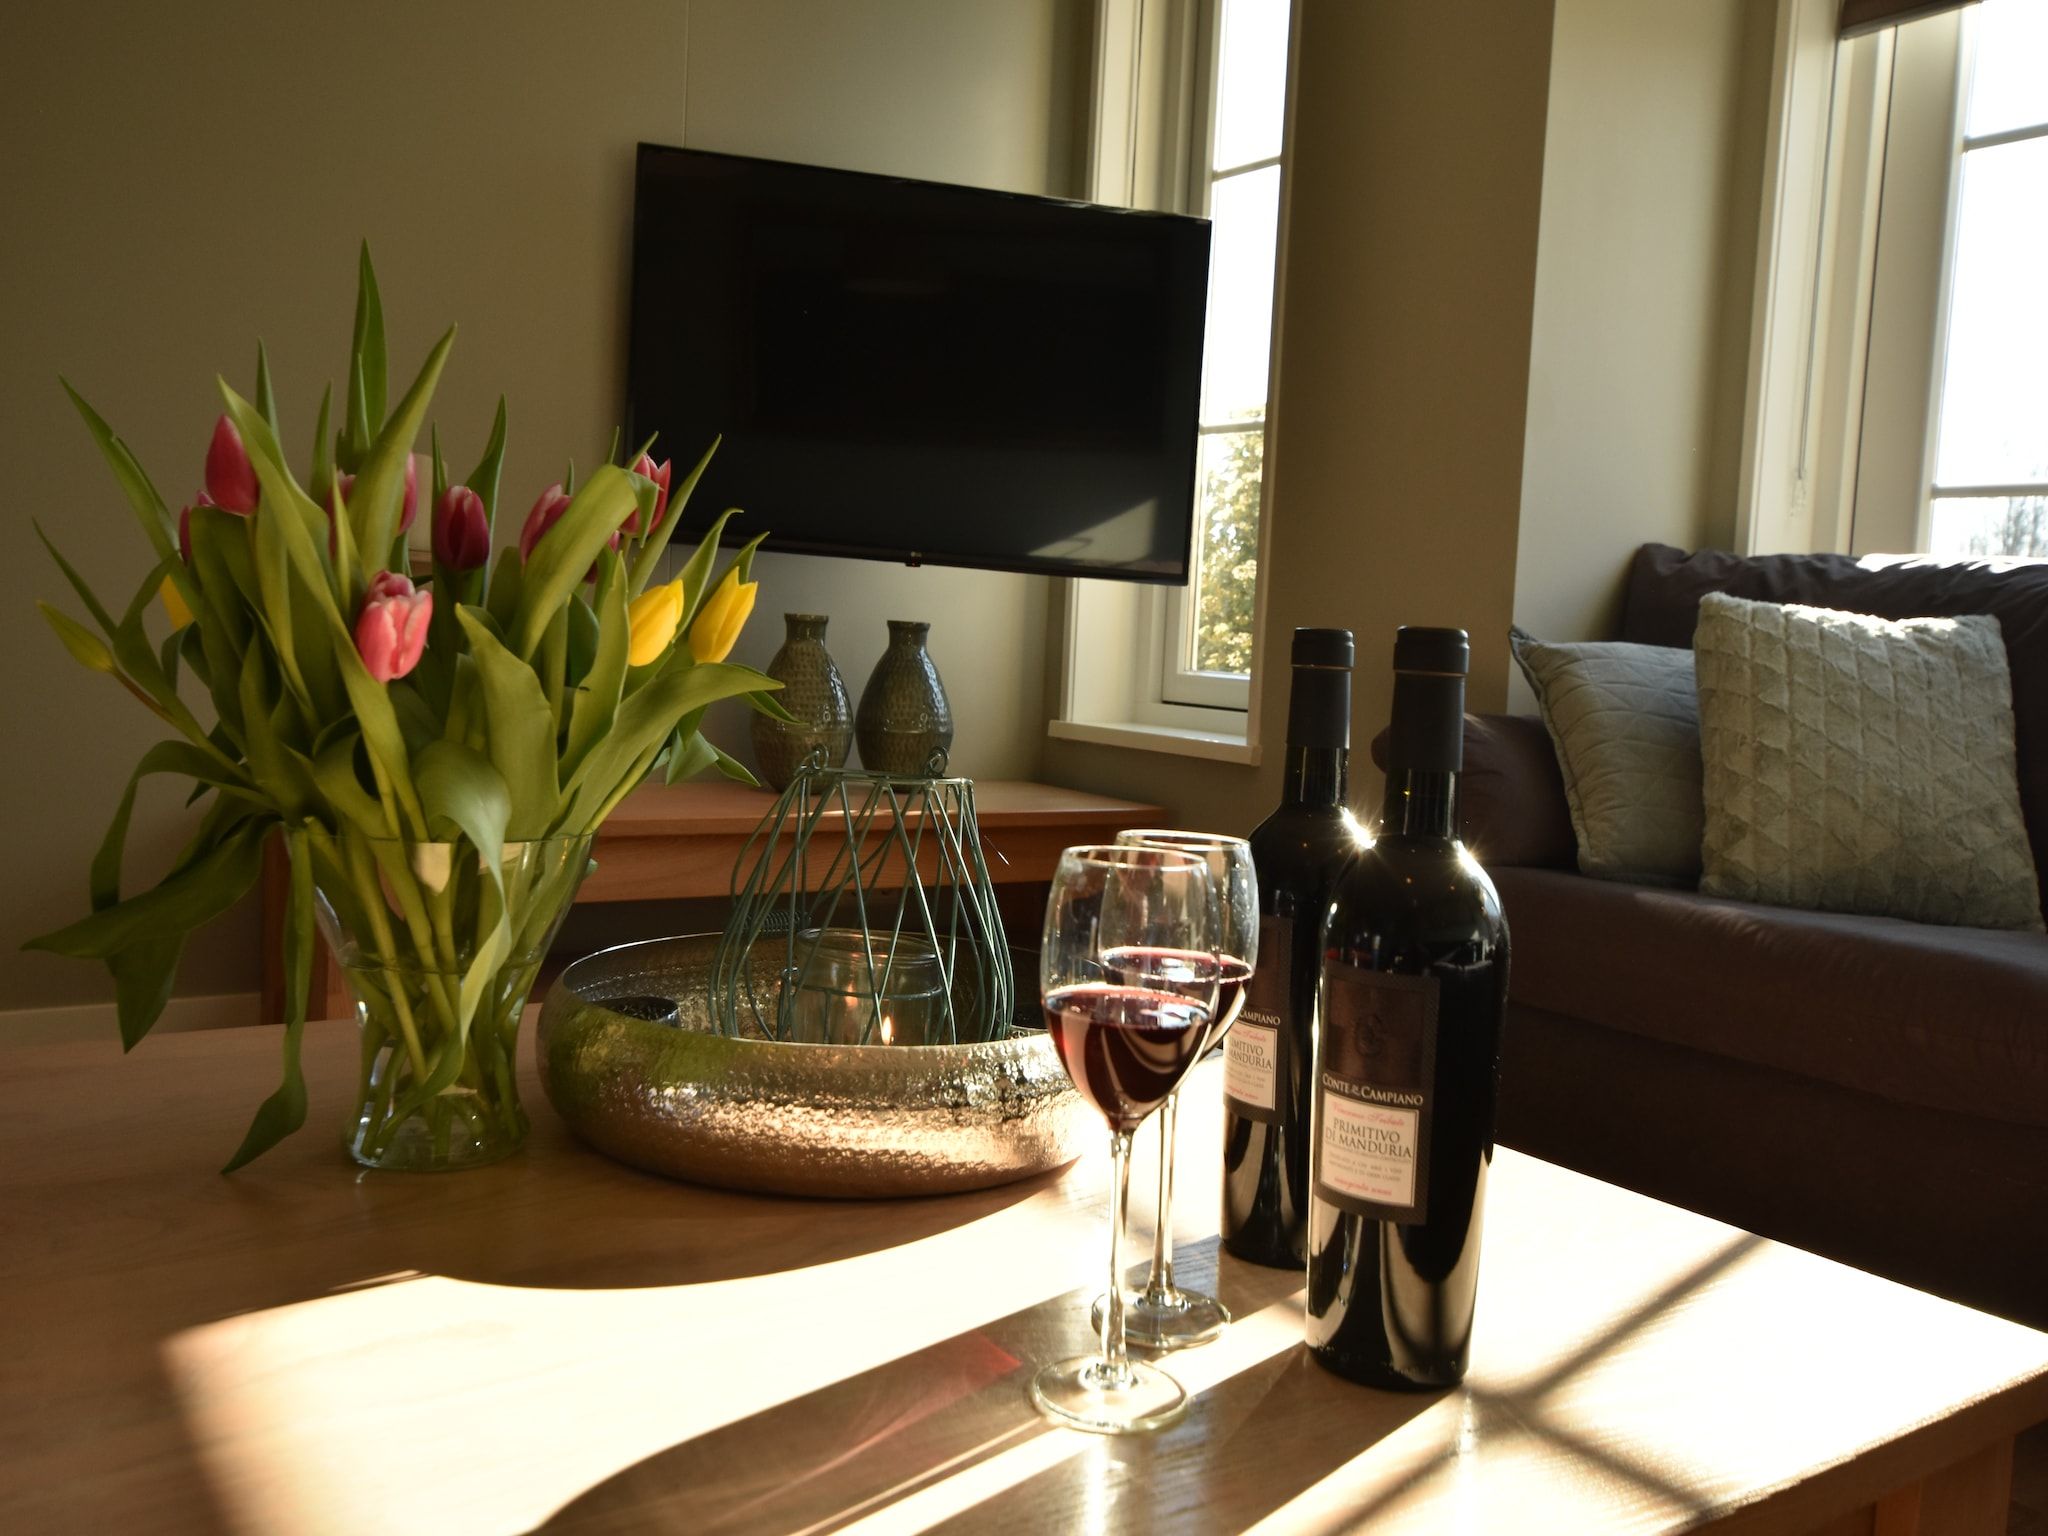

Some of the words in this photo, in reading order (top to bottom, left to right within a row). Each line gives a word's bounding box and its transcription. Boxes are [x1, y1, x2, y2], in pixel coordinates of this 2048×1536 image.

[1322, 1072, 1350, 1094] CONTE
[1361, 1086, 1424, 1106] CAMPIANO
[1333, 1117, 1400, 1144] PRIMITIVO
[1338, 1131, 1412, 1158] MANDURIA
